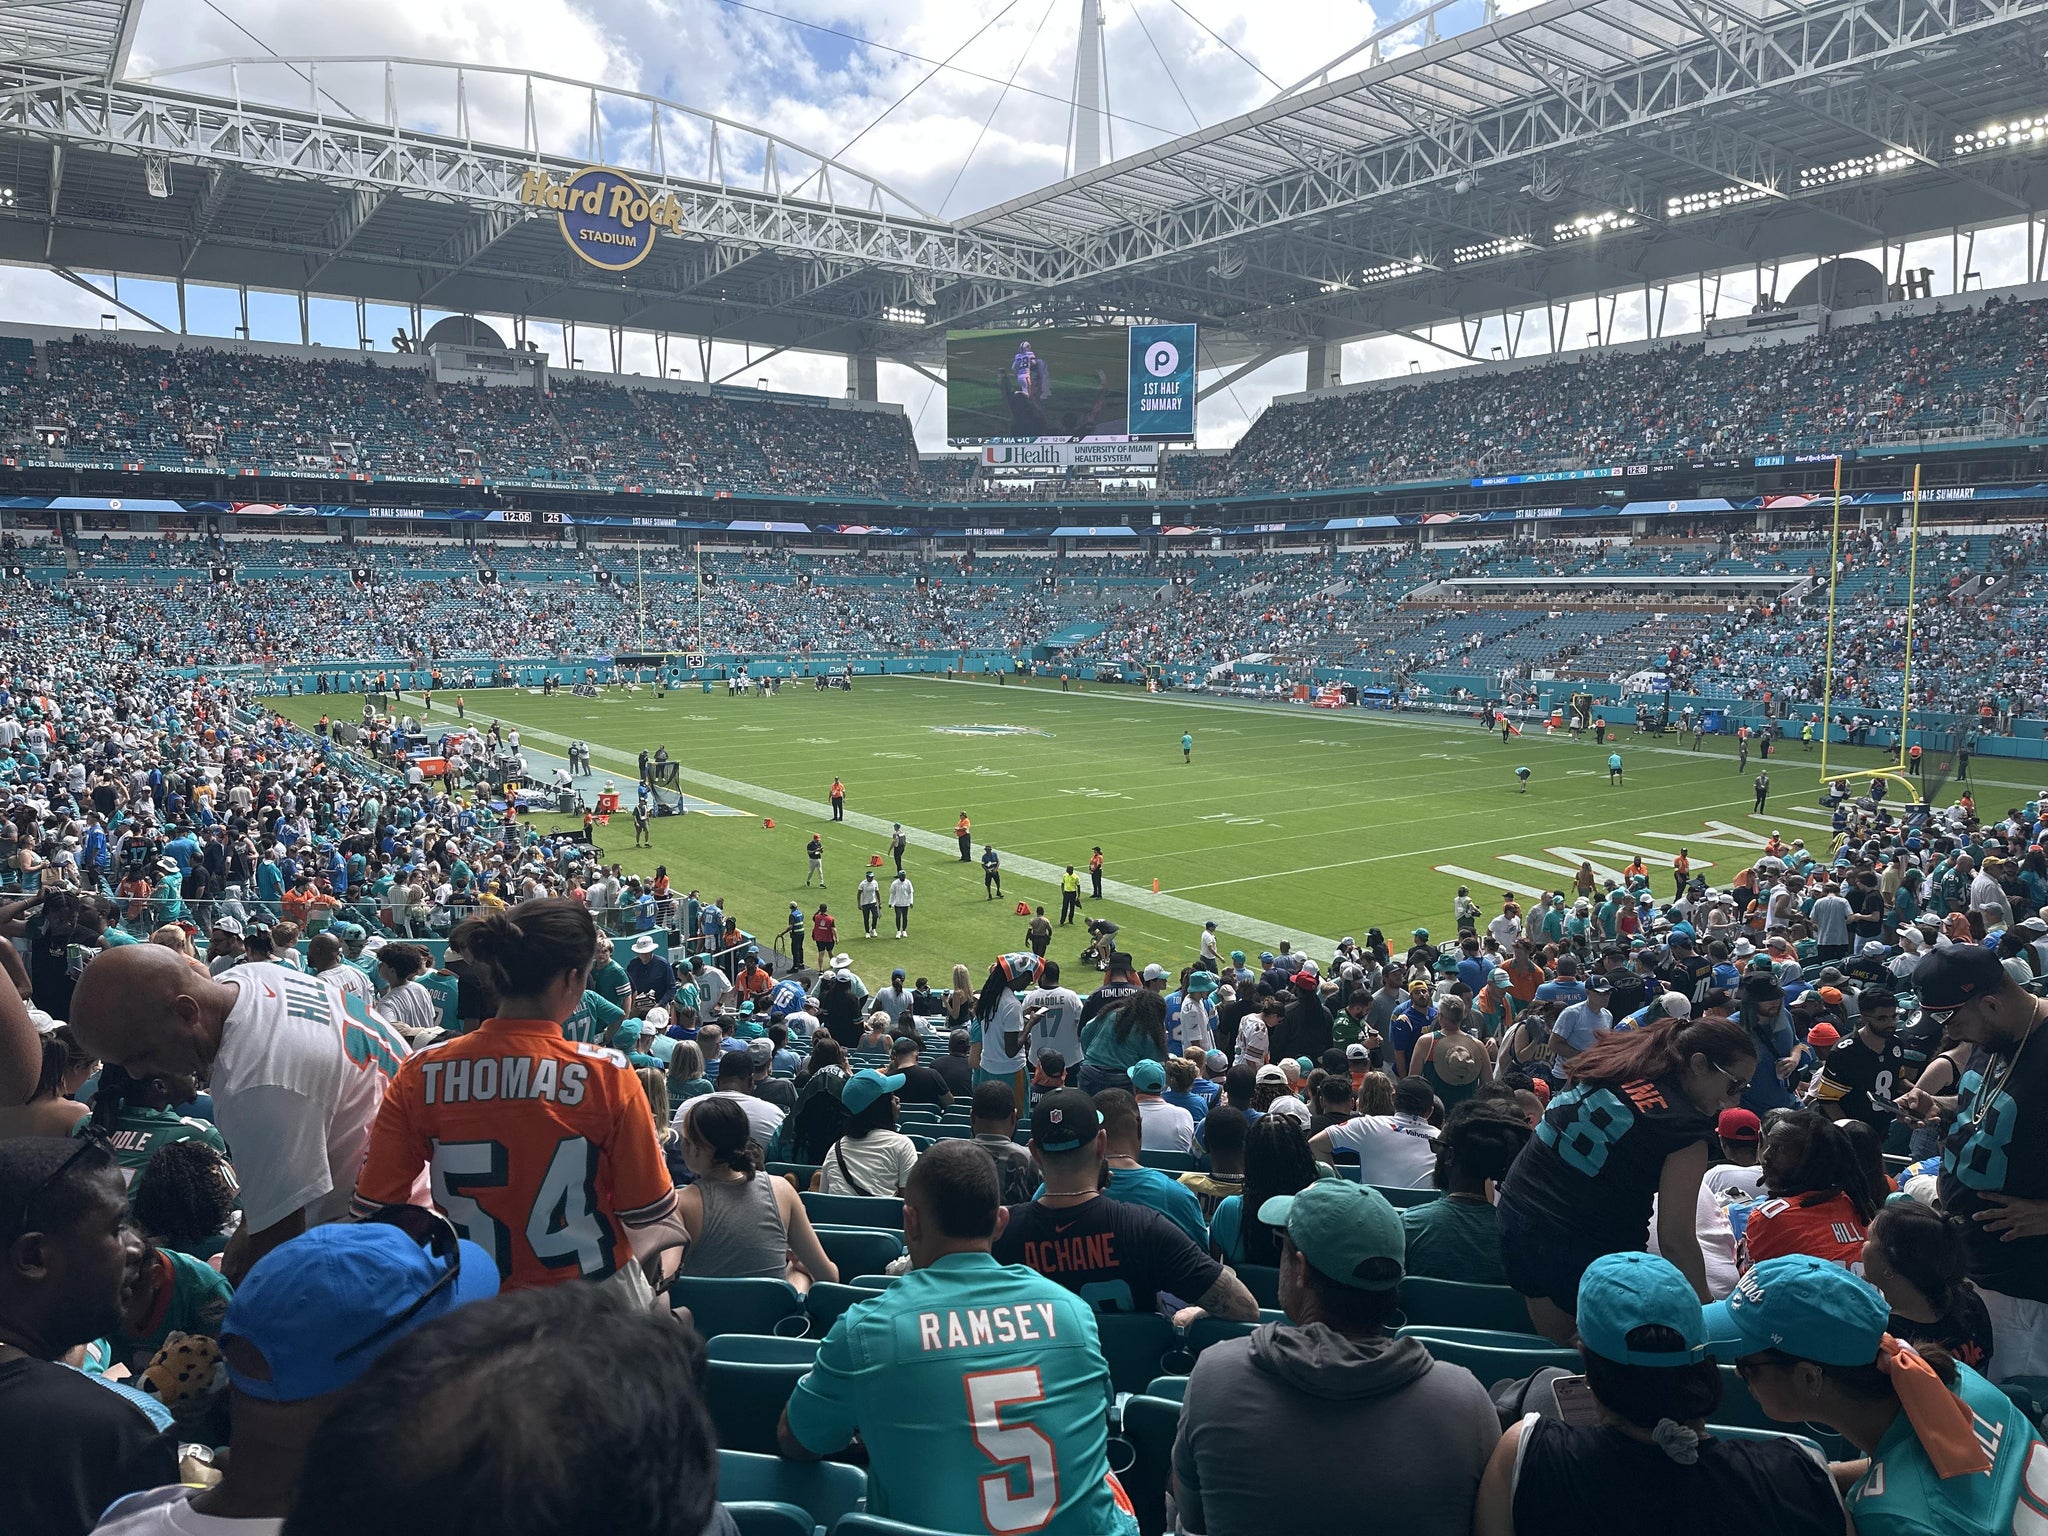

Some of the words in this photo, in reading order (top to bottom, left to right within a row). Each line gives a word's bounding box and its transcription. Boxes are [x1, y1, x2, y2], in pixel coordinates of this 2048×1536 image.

[521, 170, 606, 215] Hard
[608, 184, 684, 235] Rock
[580, 228, 637, 247] STADIUM
[102, 334, 118, 342] 329
[1751, 335, 1767, 345] 346
[232, 344, 248, 352] 330
[1143, 382, 1159, 396] 1ST
[1160, 381, 1180, 395] HALF
[1140, 397, 1183, 412] SUMMARY
[986, 445, 1060, 464] UHealth
[1075, 446, 1113, 455] UNIVERSITY
[1115, 445, 1127, 453] OF
[1128, 444, 1153, 453] MIAMI
[1075, 454, 1102, 463] HEALTH
[1103, 454, 1132, 463] SYSTEM
[28, 459, 46, 468] BOB
[48, 460, 100, 470] BAUMHOWER
[102, 462, 114, 470] 73
[160, 465, 182, 474] DOUG
[184, 465, 213, 475] BETTERS
[215, 467, 226, 475] 75
[290, 470, 328, 480] OFFERDAHL
[329, 472, 340, 480] 56
[1628, 466, 1646, 475] 12:06
[407, 475, 438, 484] CLAYTON
[1493, 477, 1508, 485] LIGHT
[545, 482, 570, 490] MARINO
[674, 488, 693, 496] DUPER
[1917, 489, 1935, 500] HALF
[1936, 488, 1975, 500] SUMMARY
[369, 507, 380, 517] 1ST
[380, 508, 395, 517] HALF
[396, 508, 424, 518] SUMMARY
[503, 512, 530, 522] 12:06
[547, 513, 559, 522] 25
[1515, 510, 1524, 518] 1ST
[1524, 509, 1537, 518] HALF
[1537, 507, 1562, 517] SUMMARY
[632, 517, 641, 525] 1ST
[642, 517, 653, 526] HALF
[653, 518, 677, 527] SUMMARY
[689, 656, 702, 667] 25
[829, 666, 865, 674] Dolpins
[602, 798, 611, 807] G
[460, 816, 469, 828] 10
[132, 846, 148, 860] 17
[505, 881, 515, 896] 10
[705, 914, 713, 924] 10
[1851, 969, 1868, 979] JAMES
[1870, 972, 1879, 981] JR
[1691, 977, 1711, 1004] 10
[284, 977, 331, 1026] HILL
[774, 988, 795, 1008] 10
[1034, 995, 1065, 1006] WADDLE
[1555, 993, 1582, 1001] HOPKINS
[1039, 1007, 1064, 1038] 17
[567, 1016, 592, 1044] 17
[1837, 1038, 1853, 1049] 8
[422, 1056, 589, 1107] THOMAS
[1874, 1070, 1893, 1111] 8
[430, 1136, 616, 1280] 54
[1830, 1222, 1864, 1243] HILL
[1024, 1230, 1120, 1274] ACHANE
[918, 1302, 1058, 1353] RAMSEY
[962, 1365, 1061, 1536] 5
